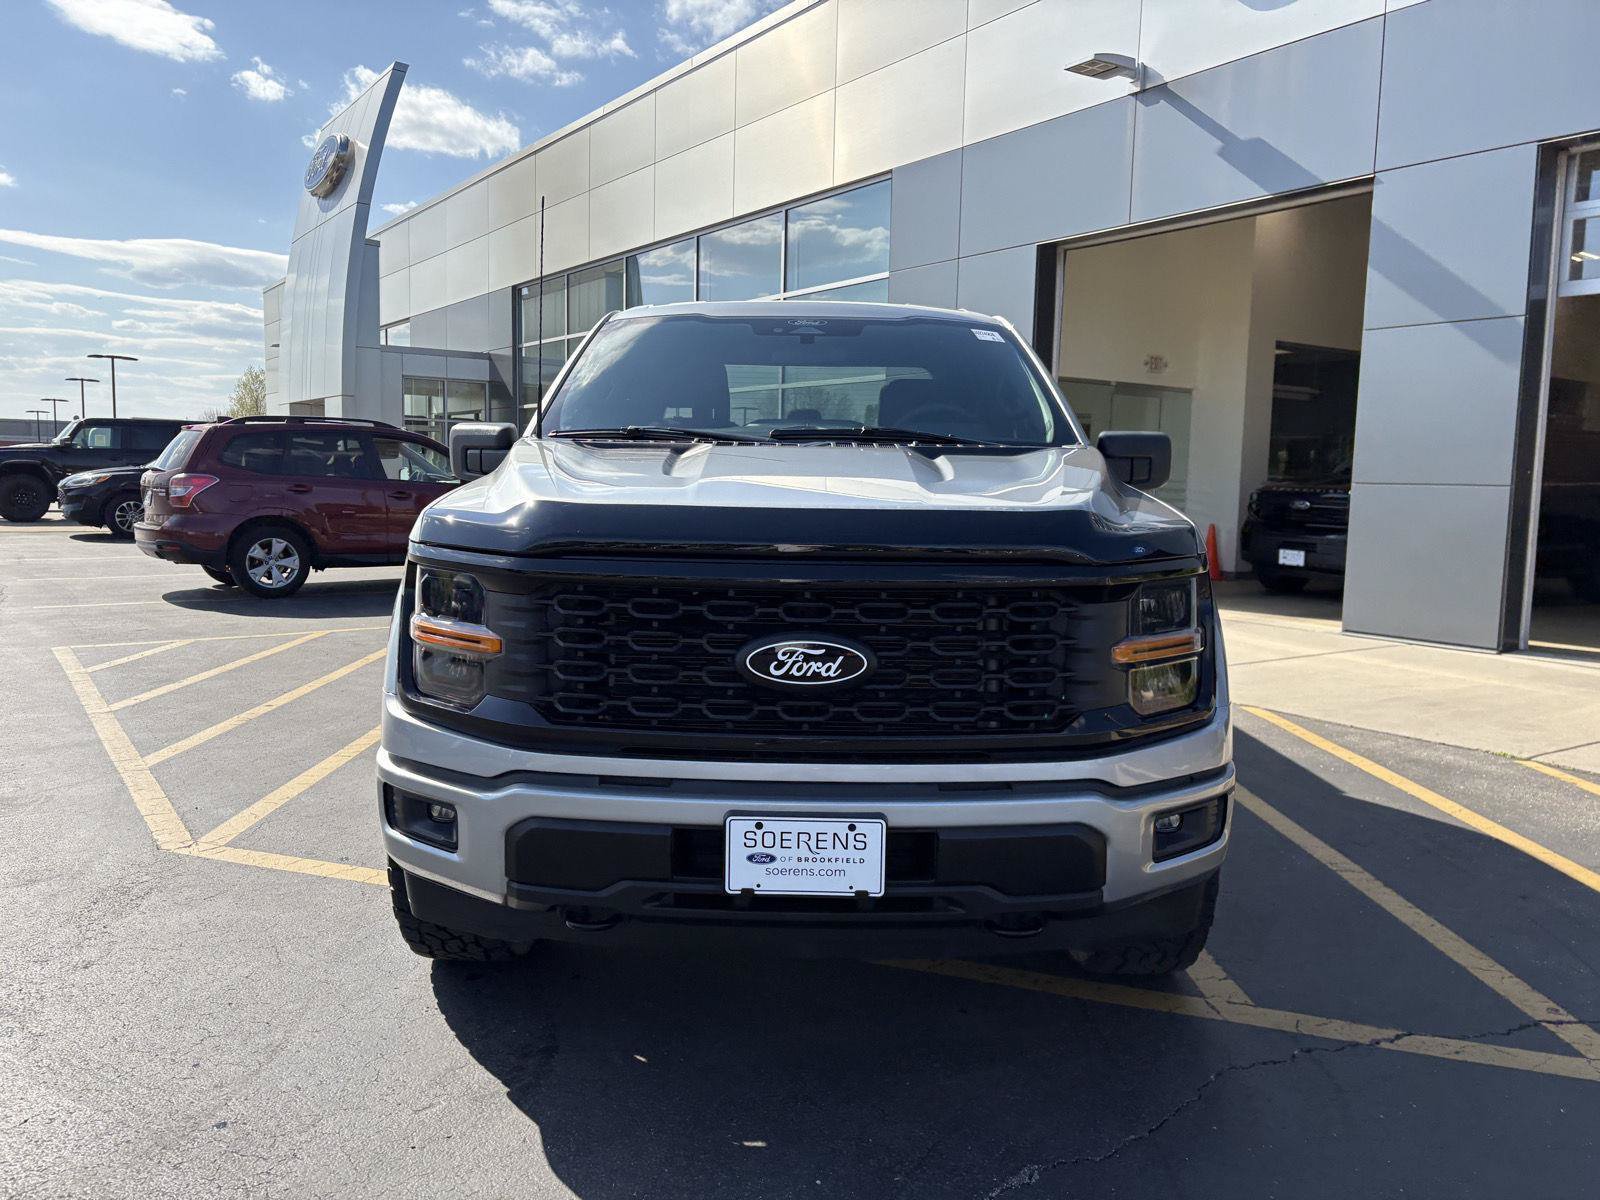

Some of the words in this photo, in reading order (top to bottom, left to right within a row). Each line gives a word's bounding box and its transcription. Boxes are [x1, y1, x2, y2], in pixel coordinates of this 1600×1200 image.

[769, 646, 844, 677] Ford
[743, 830, 867, 854] SOERENS
[797, 856, 865, 864] BROOKFIELD
[765, 867, 846, 877] soerens.com
